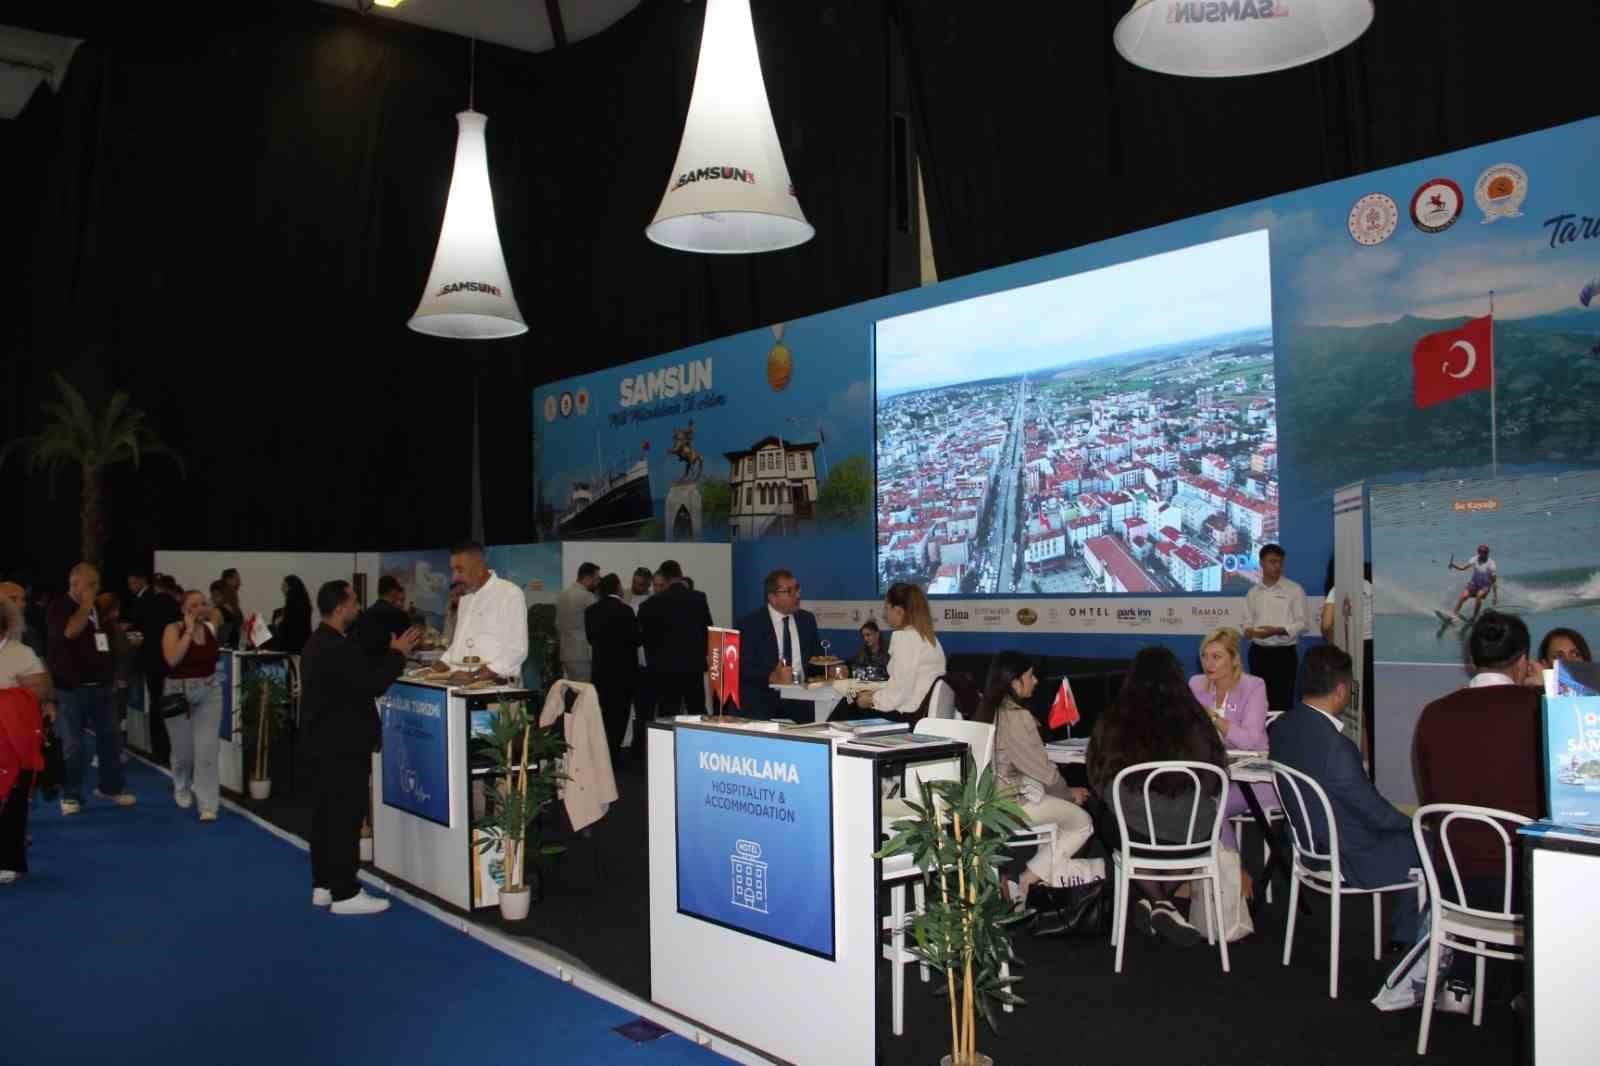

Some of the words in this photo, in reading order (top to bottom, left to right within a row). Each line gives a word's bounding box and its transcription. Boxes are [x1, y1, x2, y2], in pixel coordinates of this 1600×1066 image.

[678, 165, 747, 184] SAMSUN
[442, 281, 498, 296] SAMSUN
[619, 357, 713, 407] SAMSUN
[944, 608, 969, 620] Elina
[1117, 608, 1136, 619] park
[1137, 607, 1152, 617] inn
[699, 751, 801, 784] KONAKLAMA
[712, 780, 776, 801] HOSPITALITY
[779, 791, 786, 804] &
[704, 796, 796, 823] ACCOMMODATION
